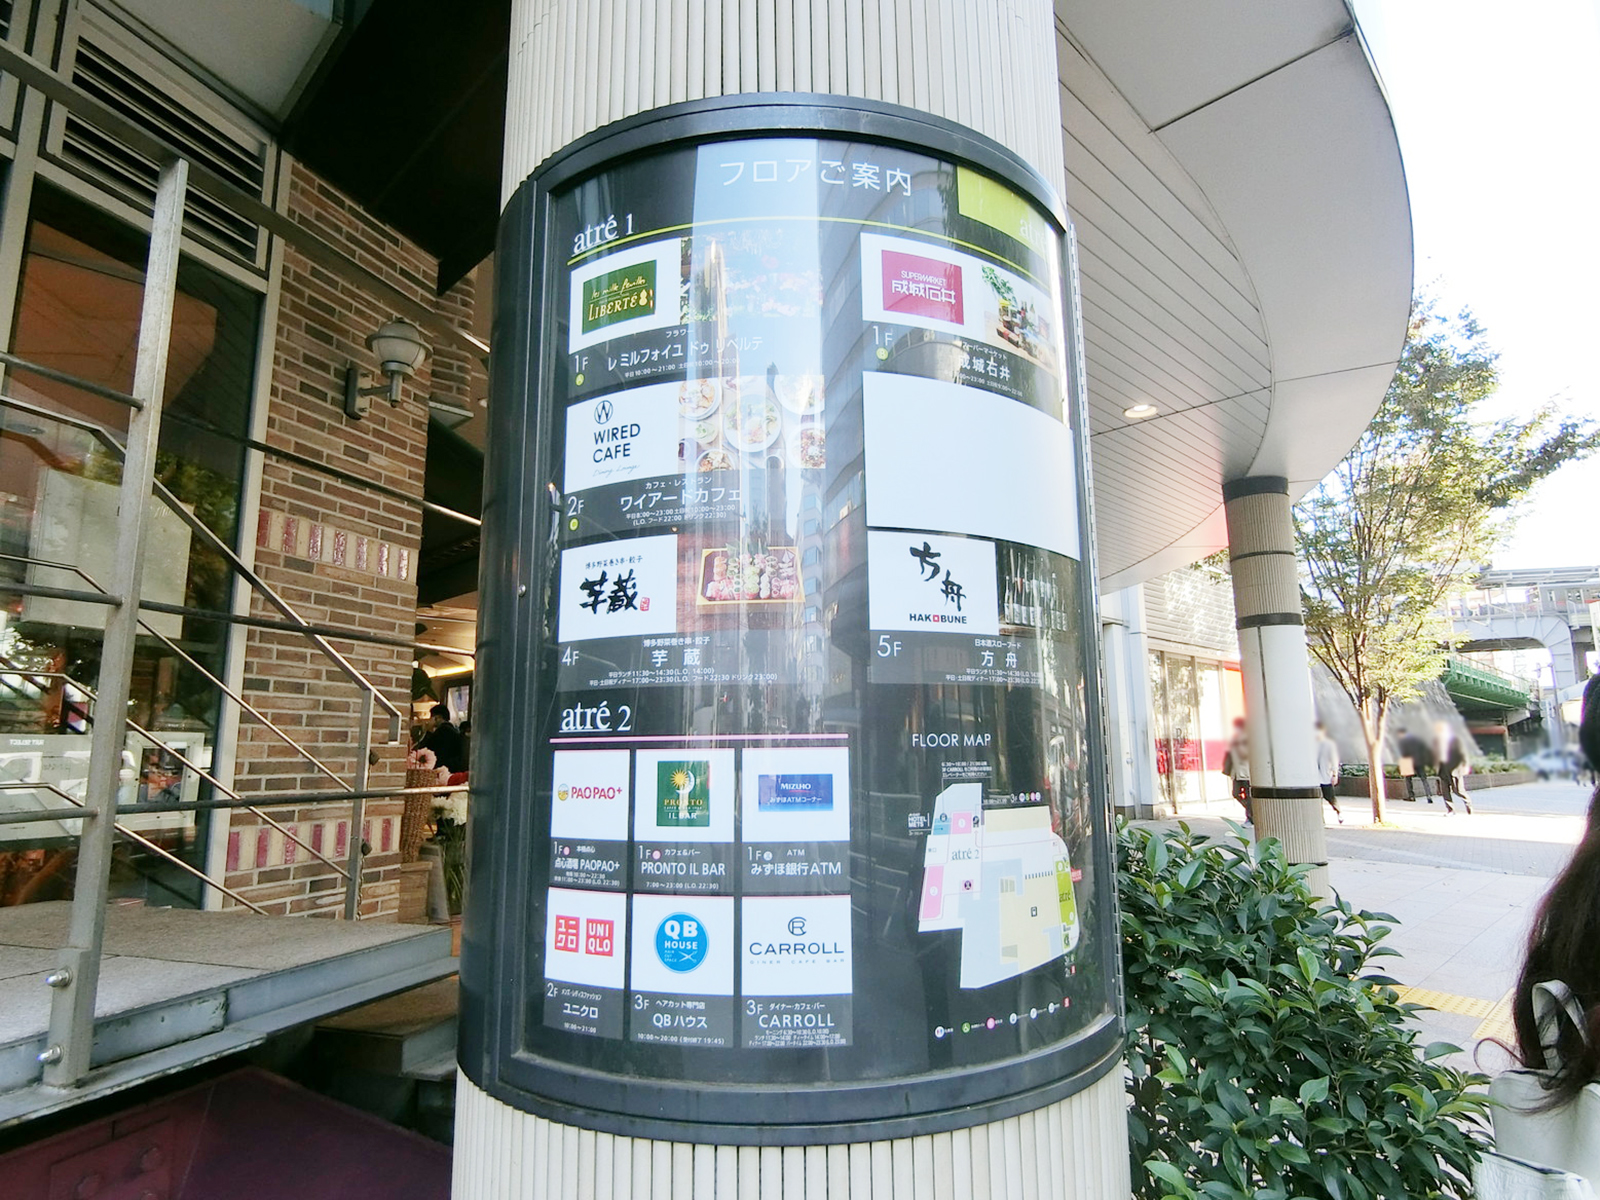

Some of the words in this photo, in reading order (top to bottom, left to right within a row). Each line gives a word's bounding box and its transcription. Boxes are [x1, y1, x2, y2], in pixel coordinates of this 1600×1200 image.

[719, 158, 912, 197] フロアご案内
[572, 213, 619, 254] atré
[901, 270, 947, 287] SUPERMARKET
[891, 279, 957, 305] 成城石井
[665, 328, 695, 339] フラワー
[872, 325, 894, 347] 1F
[574, 354, 590, 374] 1F
[593, 423, 641, 446] WIRED
[592, 442, 631, 464] CAFE
[567, 495, 585, 517] 2F
[620, 487, 741, 512] ワイアードカフェ
[876, 634, 902, 658] 5F
[561, 646, 579, 666] 4F
[561, 700, 612, 732] atré
[617, 705, 632, 732] 2
[911, 733, 959, 748] FLOOR
[963, 733, 992, 747] MAP
[780, 782, 812, 791] MIZUHO
[638, 845, 652, 860] 1F
[747, 845, 762, 861] 1F
[786, 848, 806, 857] ATM
[640, 861, 687, 876] PRONTO
[689, 862, 700, 876] IL
[701, 862, 727, 877] BAR
[750, 861, 842, 876] みずほ銀行ATM
[588, 921, 609, 937] UNI
[664, 919, 699, 940] QB
[587, 938, 611, 954] QLO
[664, 939, 699, 951] HOUSE
[749, 941, 845, 956] CARROLL
[547, 982, 559, 998] 2F
[562, 1002, 599, 1020] ユニクロ
[634, 994, 650, 1011] 3F
[746, 999, 764, 1016] 3F
[758, 1012, 836, 1029] CARROLL
